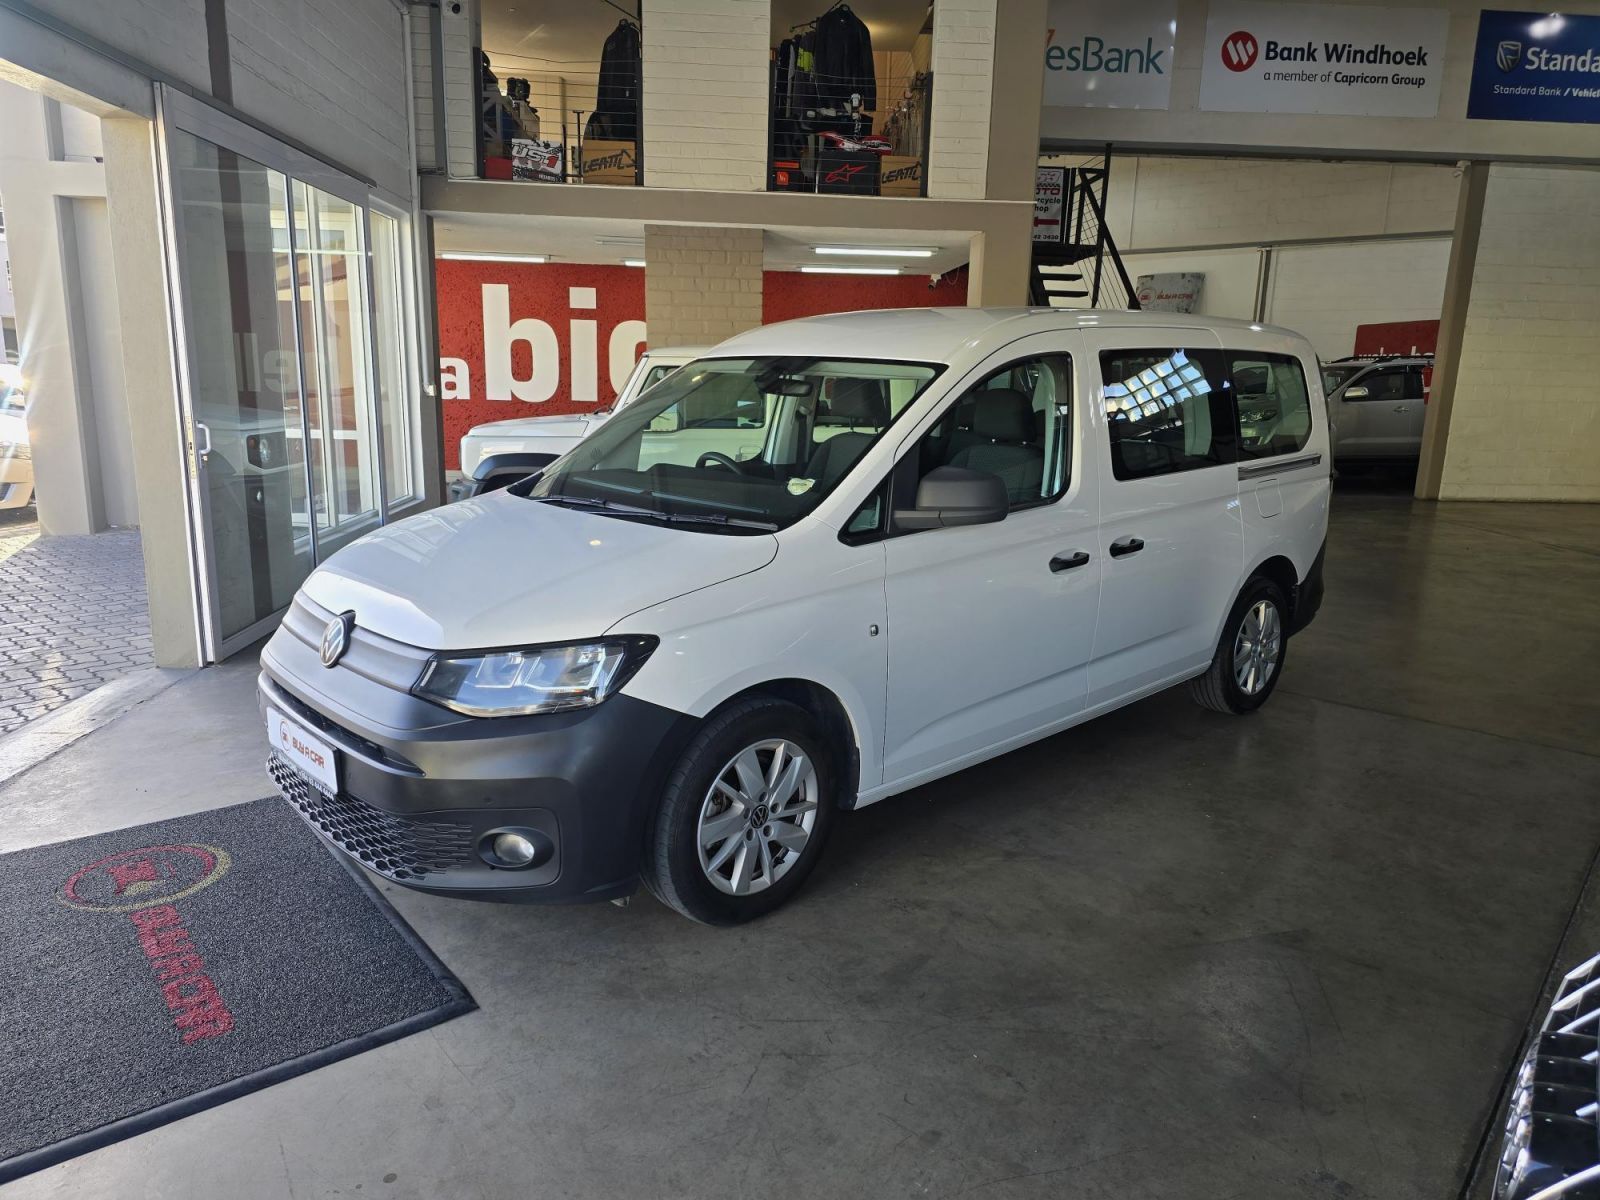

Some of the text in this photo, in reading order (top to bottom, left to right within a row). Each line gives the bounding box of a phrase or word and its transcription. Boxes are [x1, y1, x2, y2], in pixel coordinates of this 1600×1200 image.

[1046, 29, 1163, 74] esBank
[1265, 41, 1428, 66] Bank Windhoek
[1264, 71, 1425, 88] a member of Capricorn Group
[1493, 85, 1537, 95] Standard
[1538, 86, 1561, 96] Bank
[1572, 88, 1600, 98] Vehicl
